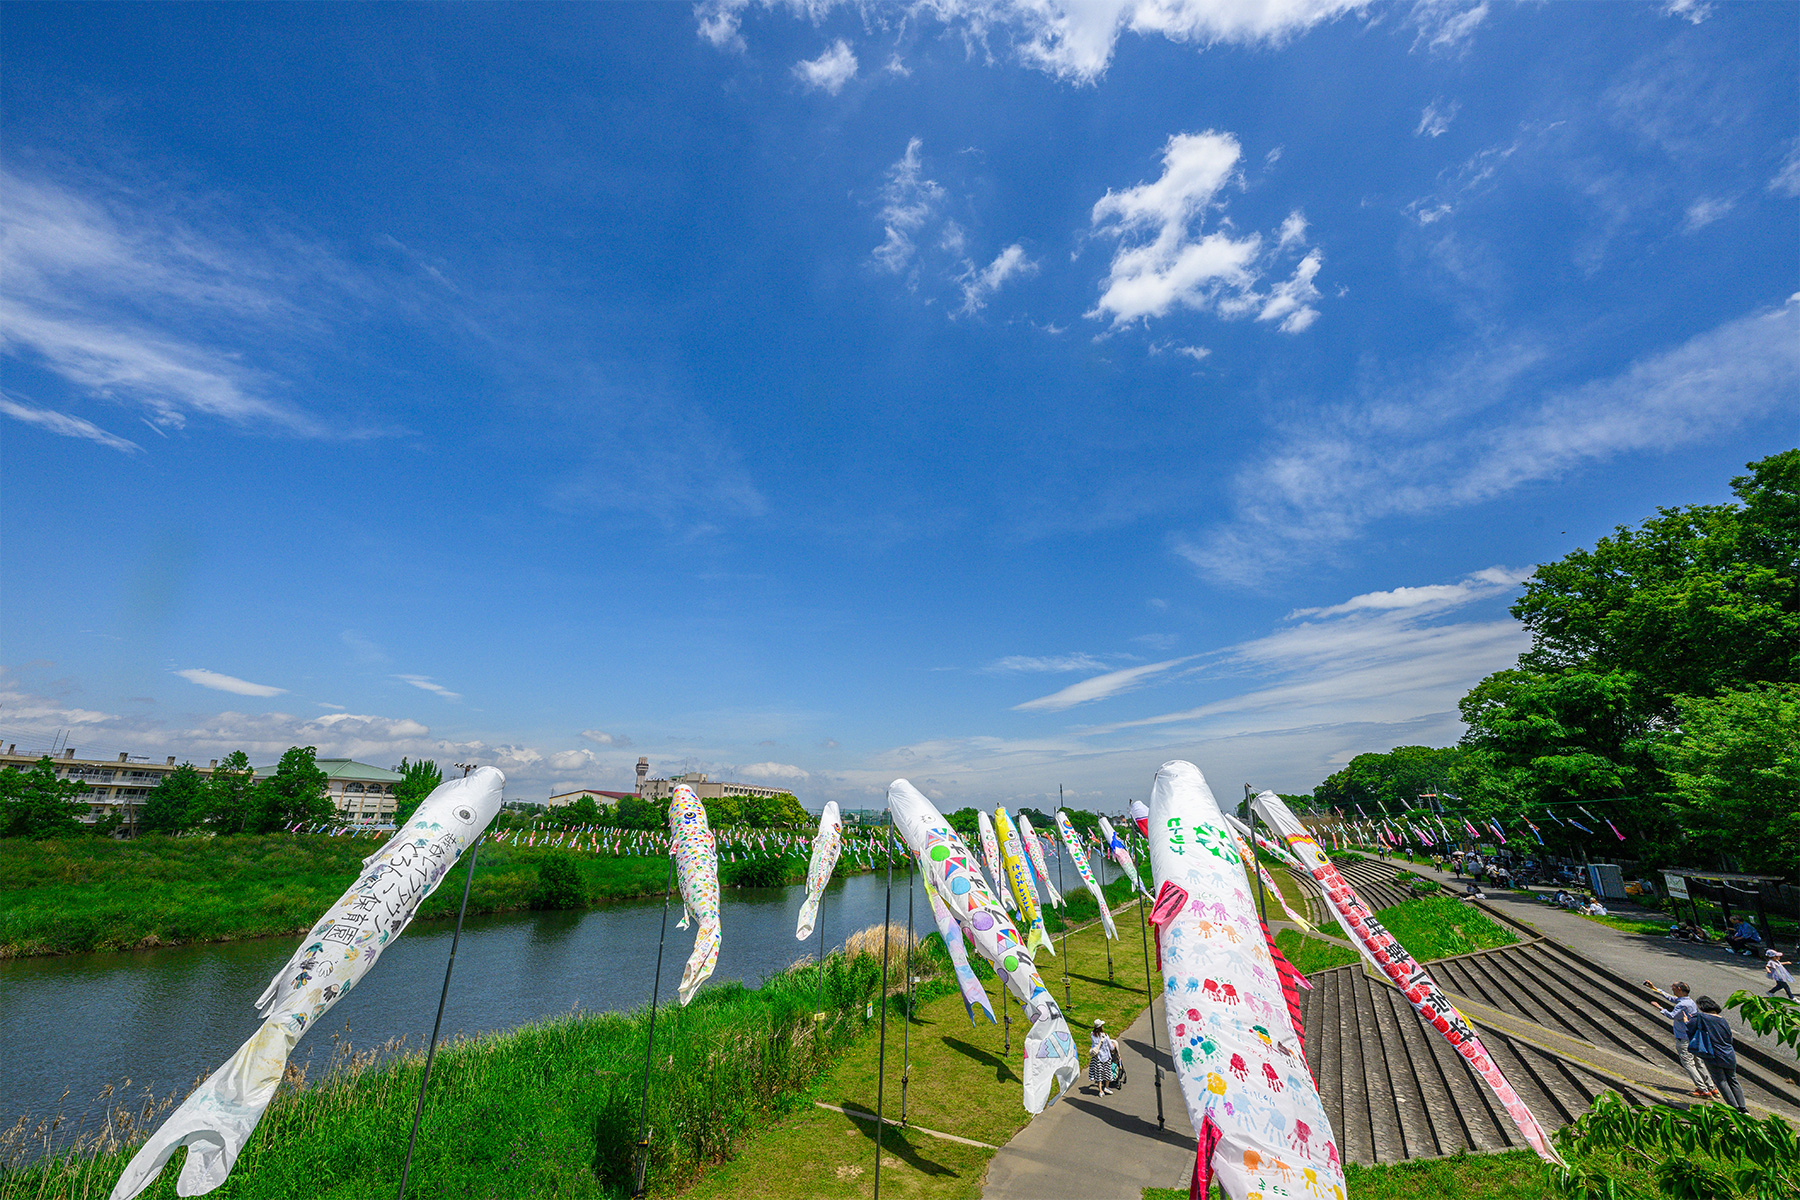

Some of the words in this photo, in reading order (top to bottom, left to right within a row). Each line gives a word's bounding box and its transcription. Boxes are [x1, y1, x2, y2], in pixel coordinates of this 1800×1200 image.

[375, 832, 457, 933] 越谷レイクタウン
[1167, 817, 1185, 856] ヒトツナ
[322, 843, 424, 946] どろんこ保育園
[1348, 894, 1476, 1042] 大相模小学校
